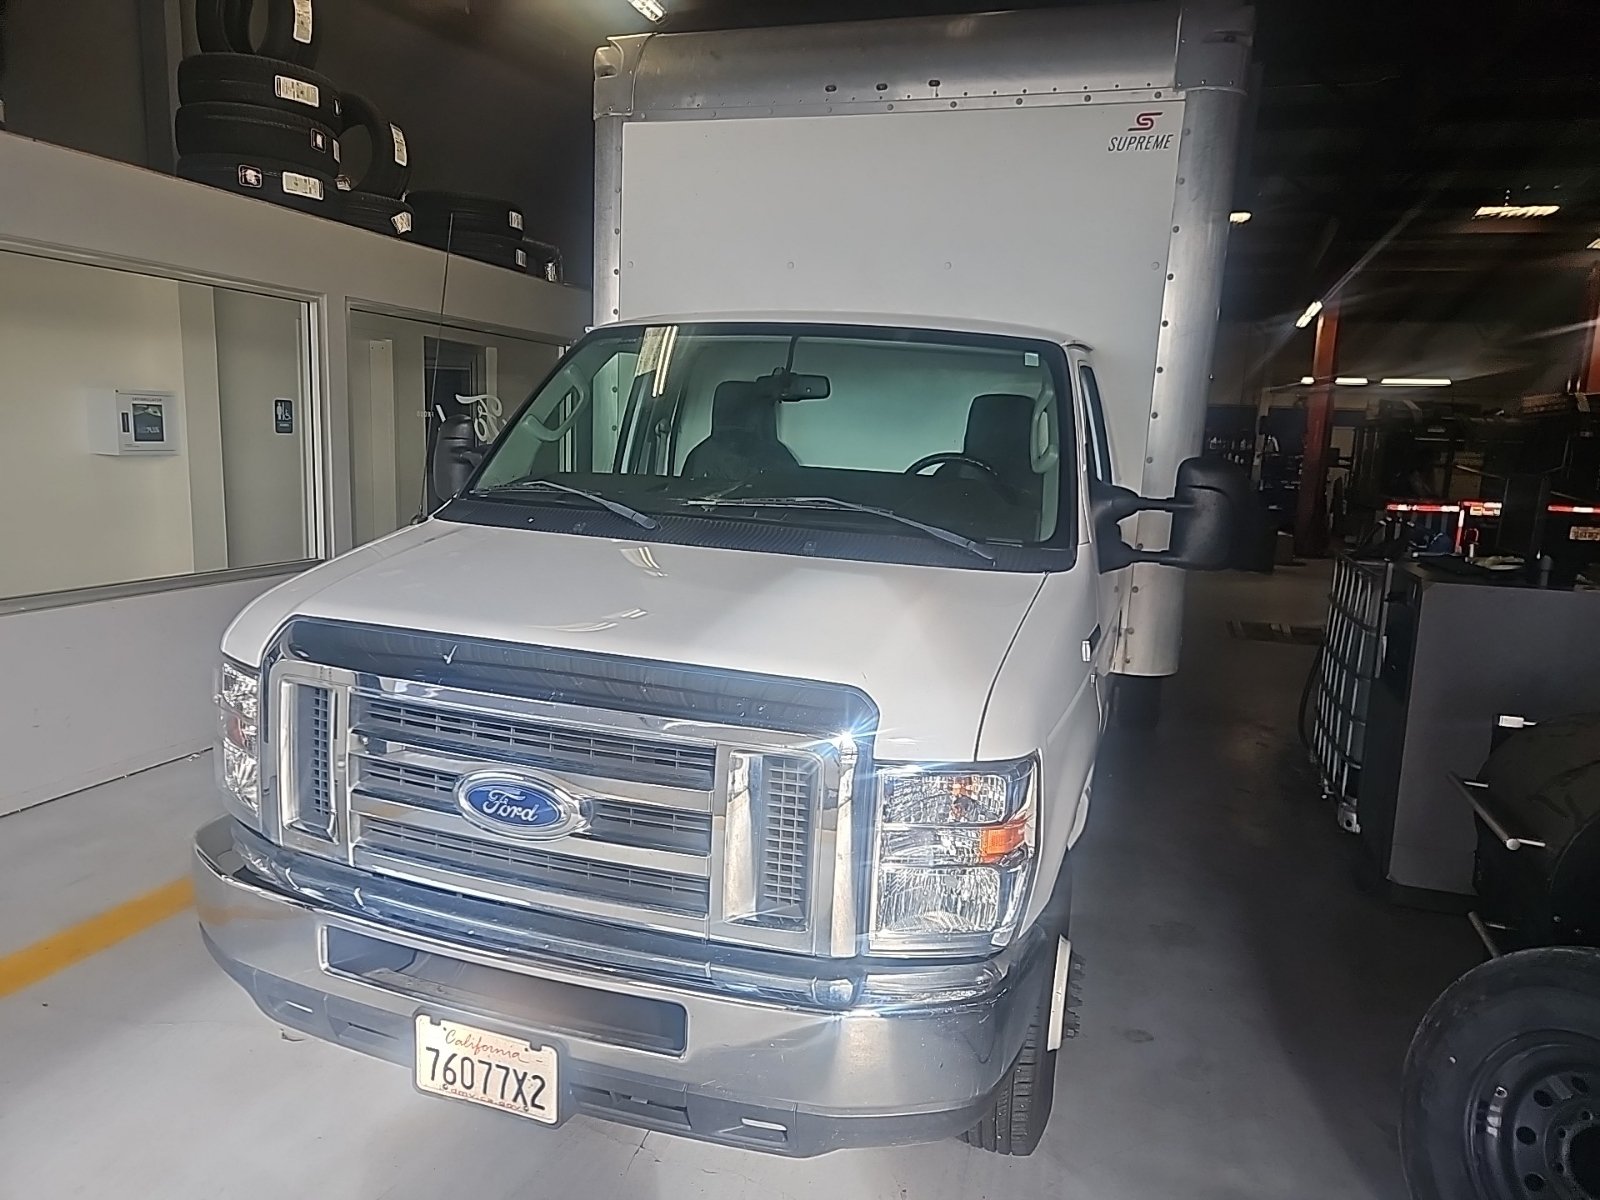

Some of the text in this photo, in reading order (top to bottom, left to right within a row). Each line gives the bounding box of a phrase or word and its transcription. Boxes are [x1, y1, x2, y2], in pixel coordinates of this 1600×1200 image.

[1108, 134, 1174, 151] SUPREME
[482, 789, 540, 822] Ford
[445, 1029, 530, 1063] California
[425, 1046, 546, 1111] 76077X2
